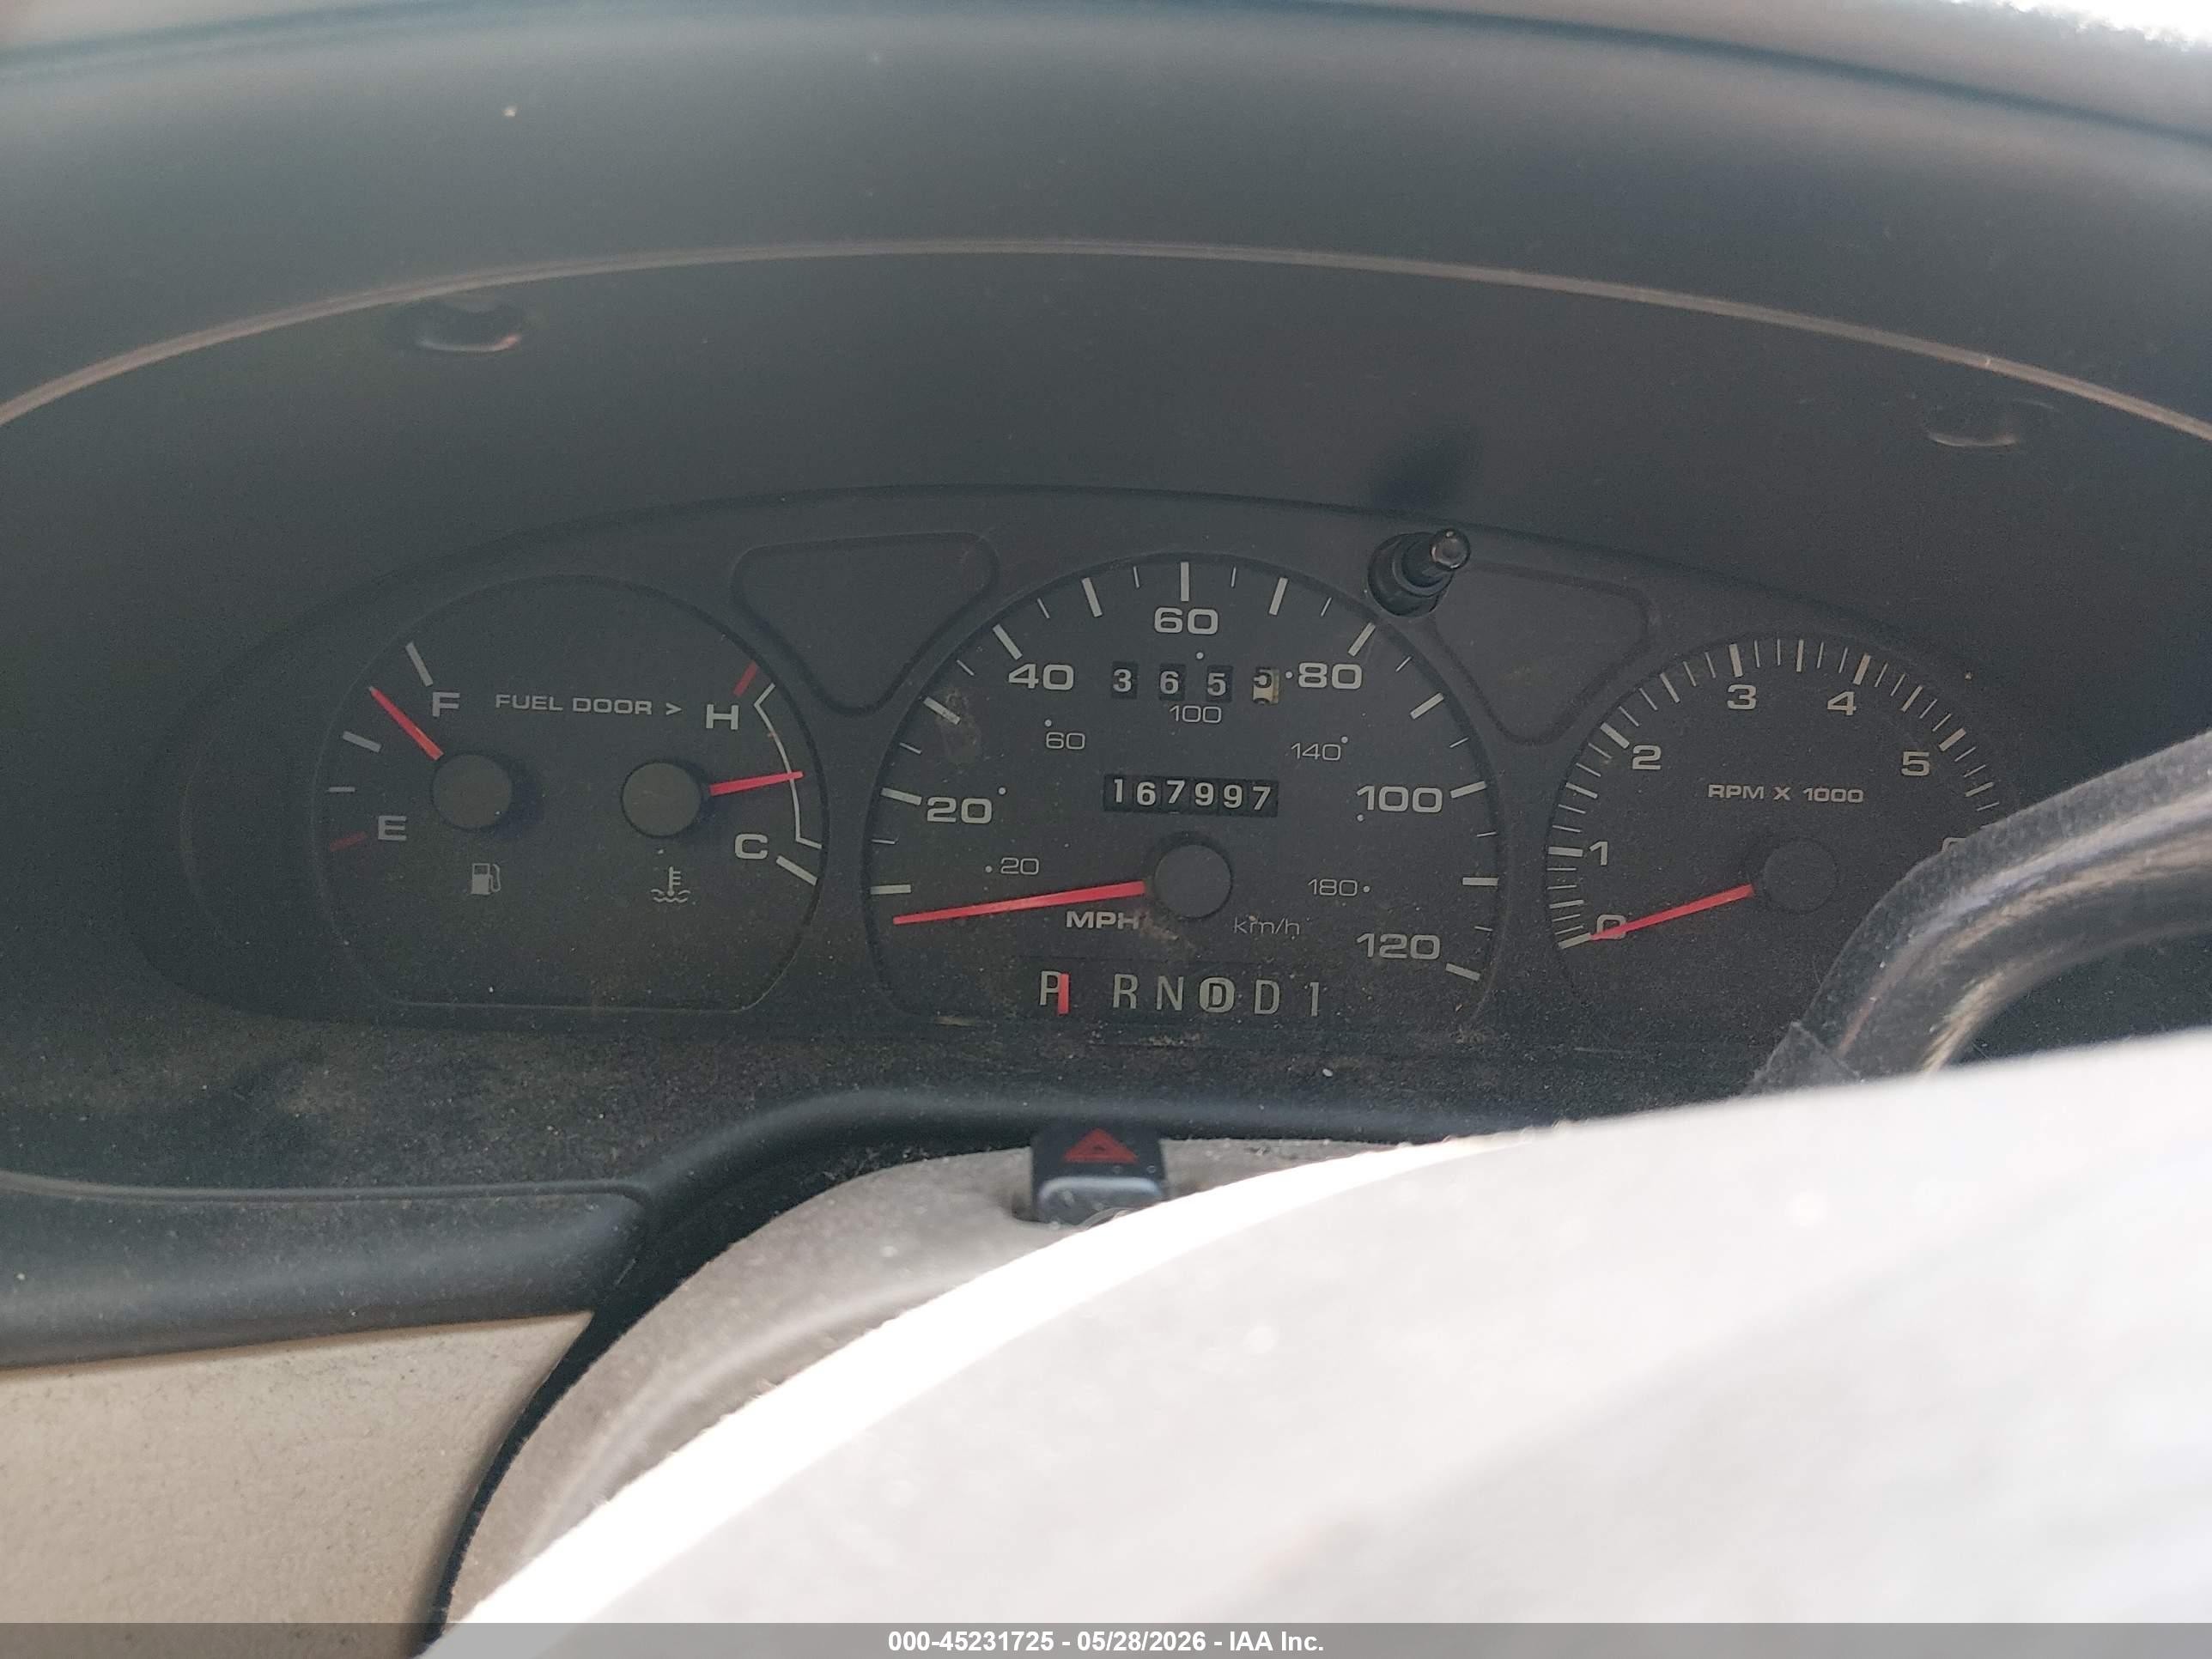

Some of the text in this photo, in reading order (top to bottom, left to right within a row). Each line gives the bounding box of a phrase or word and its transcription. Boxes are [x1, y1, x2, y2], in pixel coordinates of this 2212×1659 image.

[1154, 607, 1218, 635] 60
[1008, 663, 1074, 690] 40
[1298, 662, 1363, 690] 80
[432, 691, 460, 717] F
[495, 694, 653, 715] FUEL DOOR
[1727, 684, 1757, 710] 3
[1826, 691, 1857, 716] 4
[706, 703, 739, 730] H
[1170, 705, 1222, 724] 100
[1046, 732, 1086, 750] 60
[1291, 743, 1341, 761] 140
[1632, 744, 1662, 770] 2
[1901, 750, 1930, 776] 5
[1114, 779, 1271, 811] 167997
[1356, 785, 1443, 813] 100
[1708, 784, 1864, 803] RPM X 1000
[927, 796, 993, 824] 20
[377, 815, 407, 842] E
[734, 833, 769, 860] C
[1589, 841, 1608, 866] 1
[1000, 857, 1040, 875] 20
[1308, 878, 1358, 896] 180
[1066, 911, 1139, 930] MPH
[1234, 915, 1300, 935] km/h
[1356, 933, 1441, 960] 120
[1040, 971, 1065, 1006] P
[1113, 973, 1138, 1009] R
[1156, 975, 1184, 1011] N
[1254, 979, 1280, 1015] D
